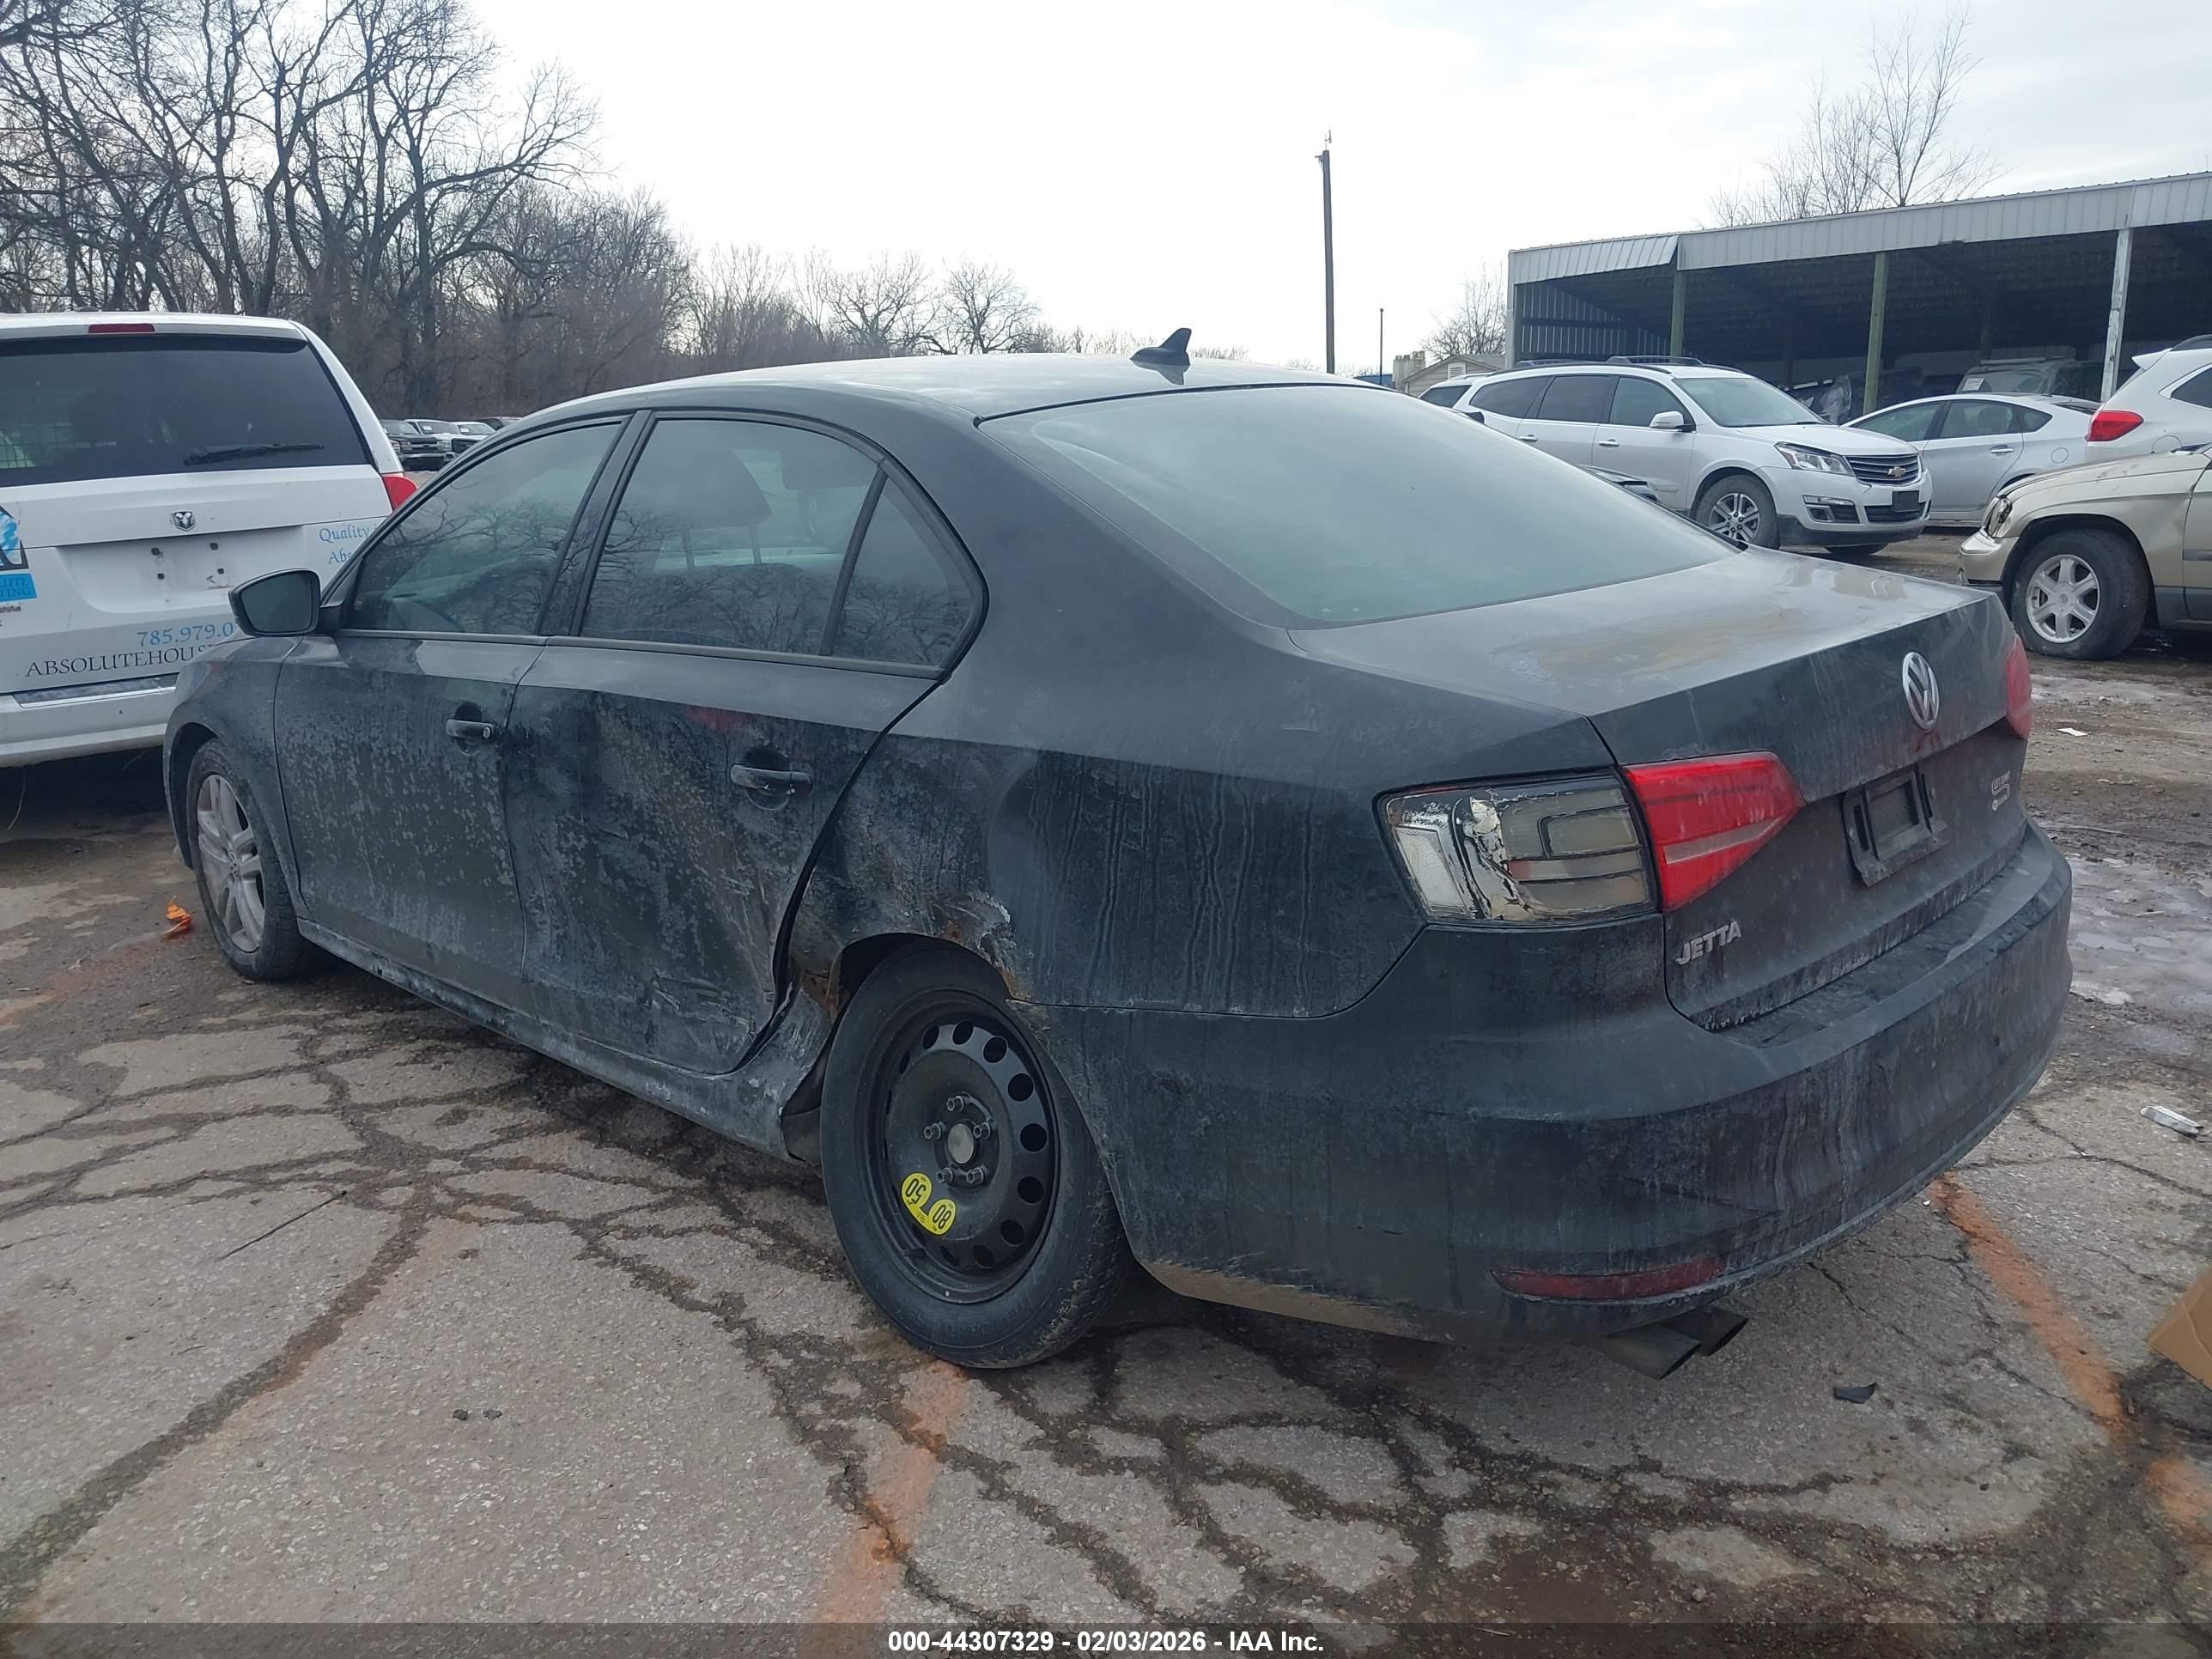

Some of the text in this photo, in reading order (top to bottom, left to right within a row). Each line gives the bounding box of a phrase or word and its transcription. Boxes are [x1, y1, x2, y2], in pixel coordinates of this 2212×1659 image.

[319, 524, 370, 544] Quality
[1675, 920, 1742, 965] JETTA
[932, 1204, 952, 1230] 80
